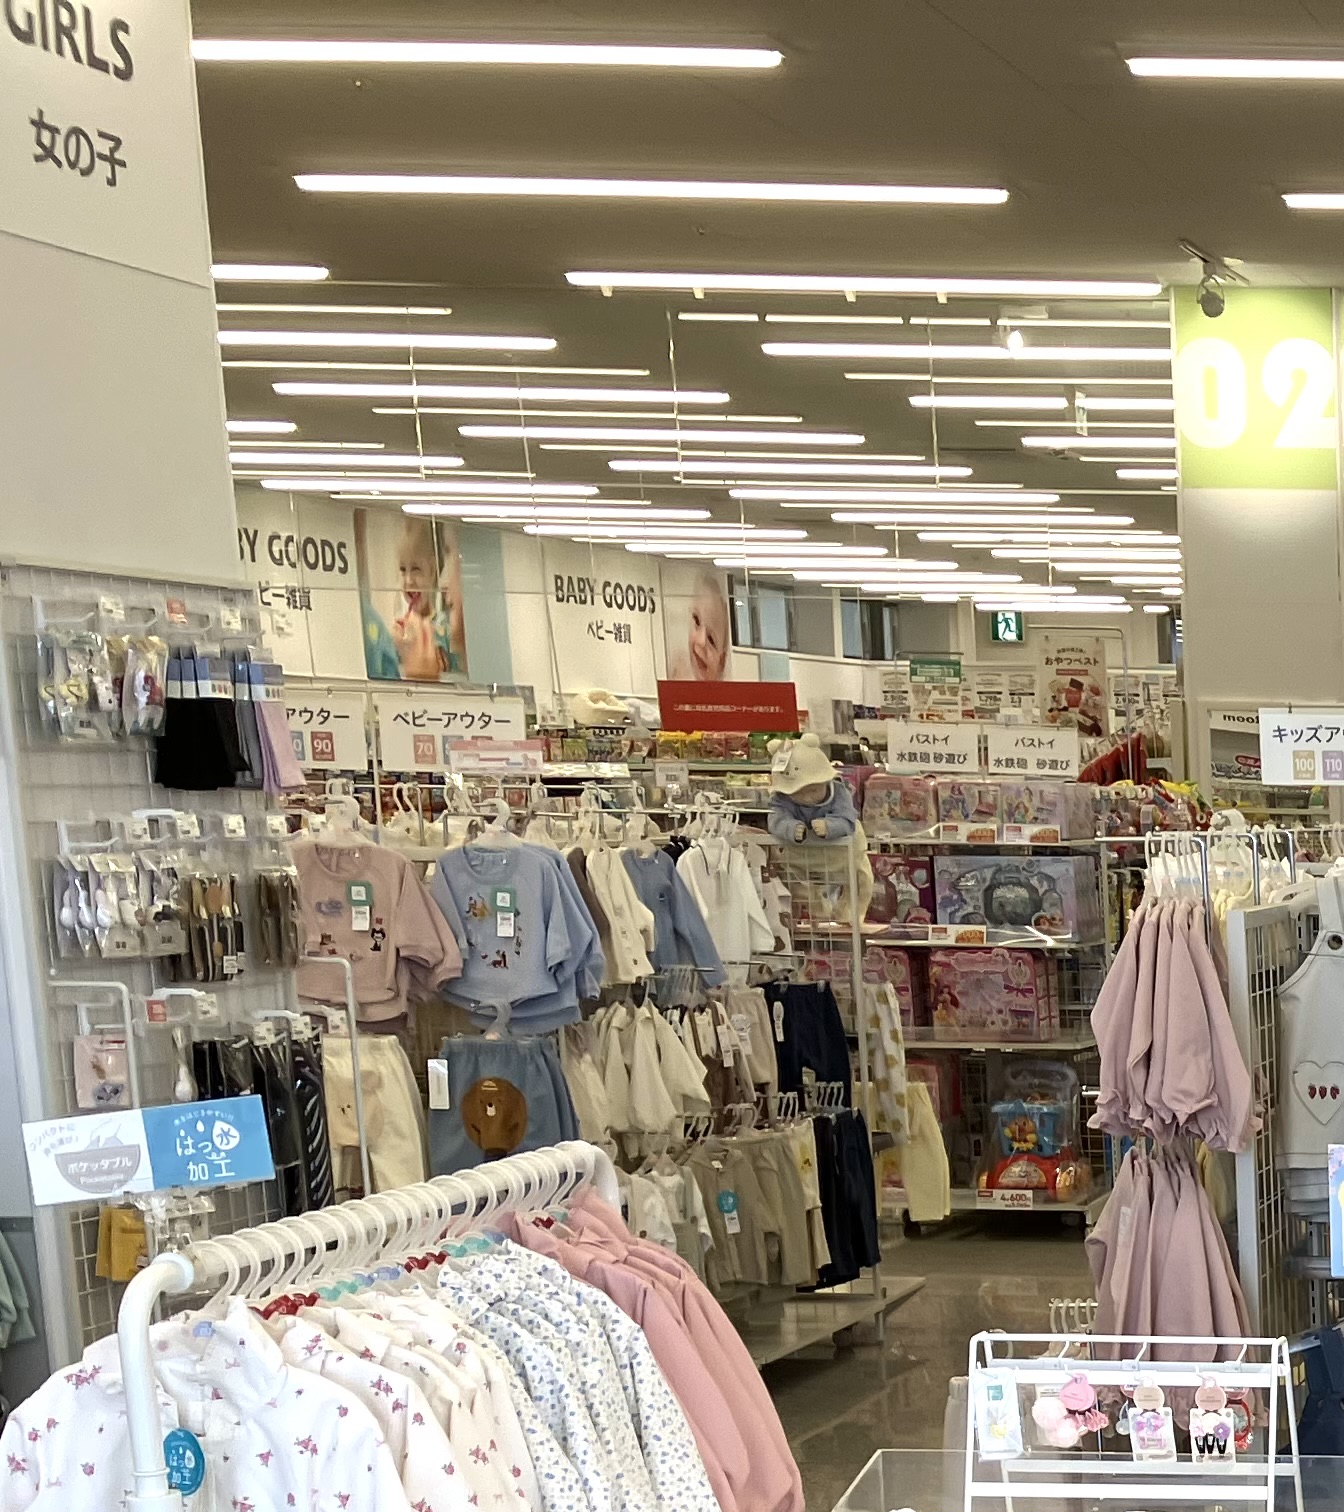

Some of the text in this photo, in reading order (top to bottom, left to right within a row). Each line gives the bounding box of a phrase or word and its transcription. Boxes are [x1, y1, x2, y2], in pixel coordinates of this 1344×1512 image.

[5, 0, 134, 81] GIRLS
[28, 107, 127, 187] 女の子
[1176, 336, 1337, 450] 02
[267, 534, 349, 574] GOODS
[258, 581, 312, 611] ビー雑貨
[555, 574, 656, 615] BABY GOODS
[587, 620, 632, 644] ベビー雑貨
[1045, 656, 1099, 666] おやつベスト
[286, 708, 350, 725] アウター
[393, 709, 511, 729] ベビーアウター
[314, 740, 331, 753] 90
[416, 742, 433, 755] 70
[1294, 758, 1314, 772] 100
[1324, 758, 1343, 772] 110
[176, 1127, 238, 1156] はっ水
[67, 1156, 132, 1174] ポケッタブル
[187, 1159, 235, 1180] 加工
